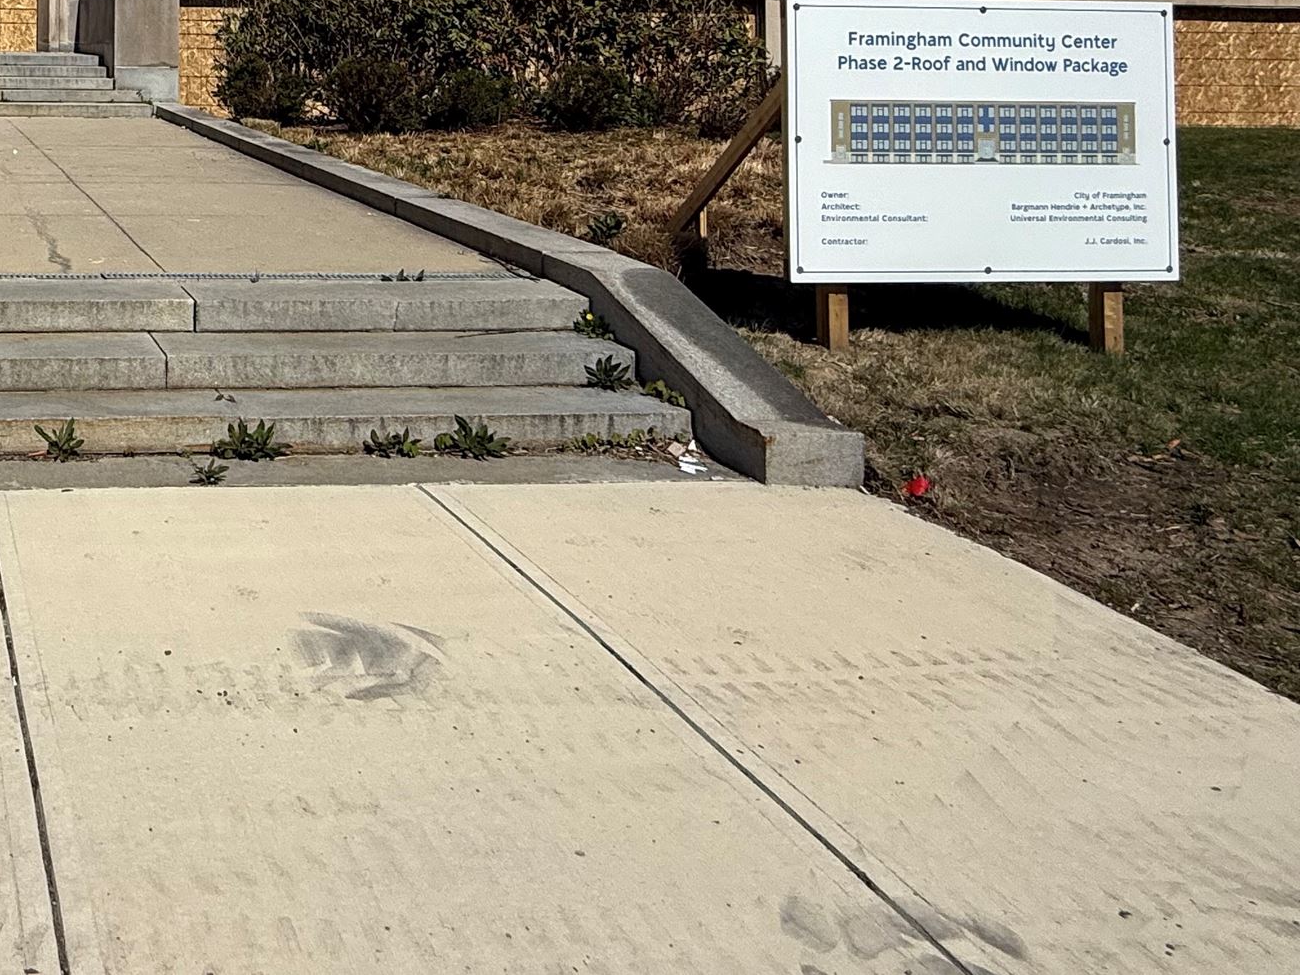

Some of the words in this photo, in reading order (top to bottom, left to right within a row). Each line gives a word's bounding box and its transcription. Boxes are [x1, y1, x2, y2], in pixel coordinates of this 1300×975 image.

[848, 32, 952, 50] Framingham
[958, 33, 1056, 51] Community
[1062, 35, 1117, 49] Center
[838, 56, 887, 71] Phase
[893, 57, 952, 71] 2-Roof
[956, 57, 986, 71] and
[992, 58, 1057, 72] Window
[1063, 59, 1128, 76] Package
[1074, 192, 1090, 200] City
[1103, 192, 1147, 200] Framingham
[1107, 215, 1147, 223] Consulting
